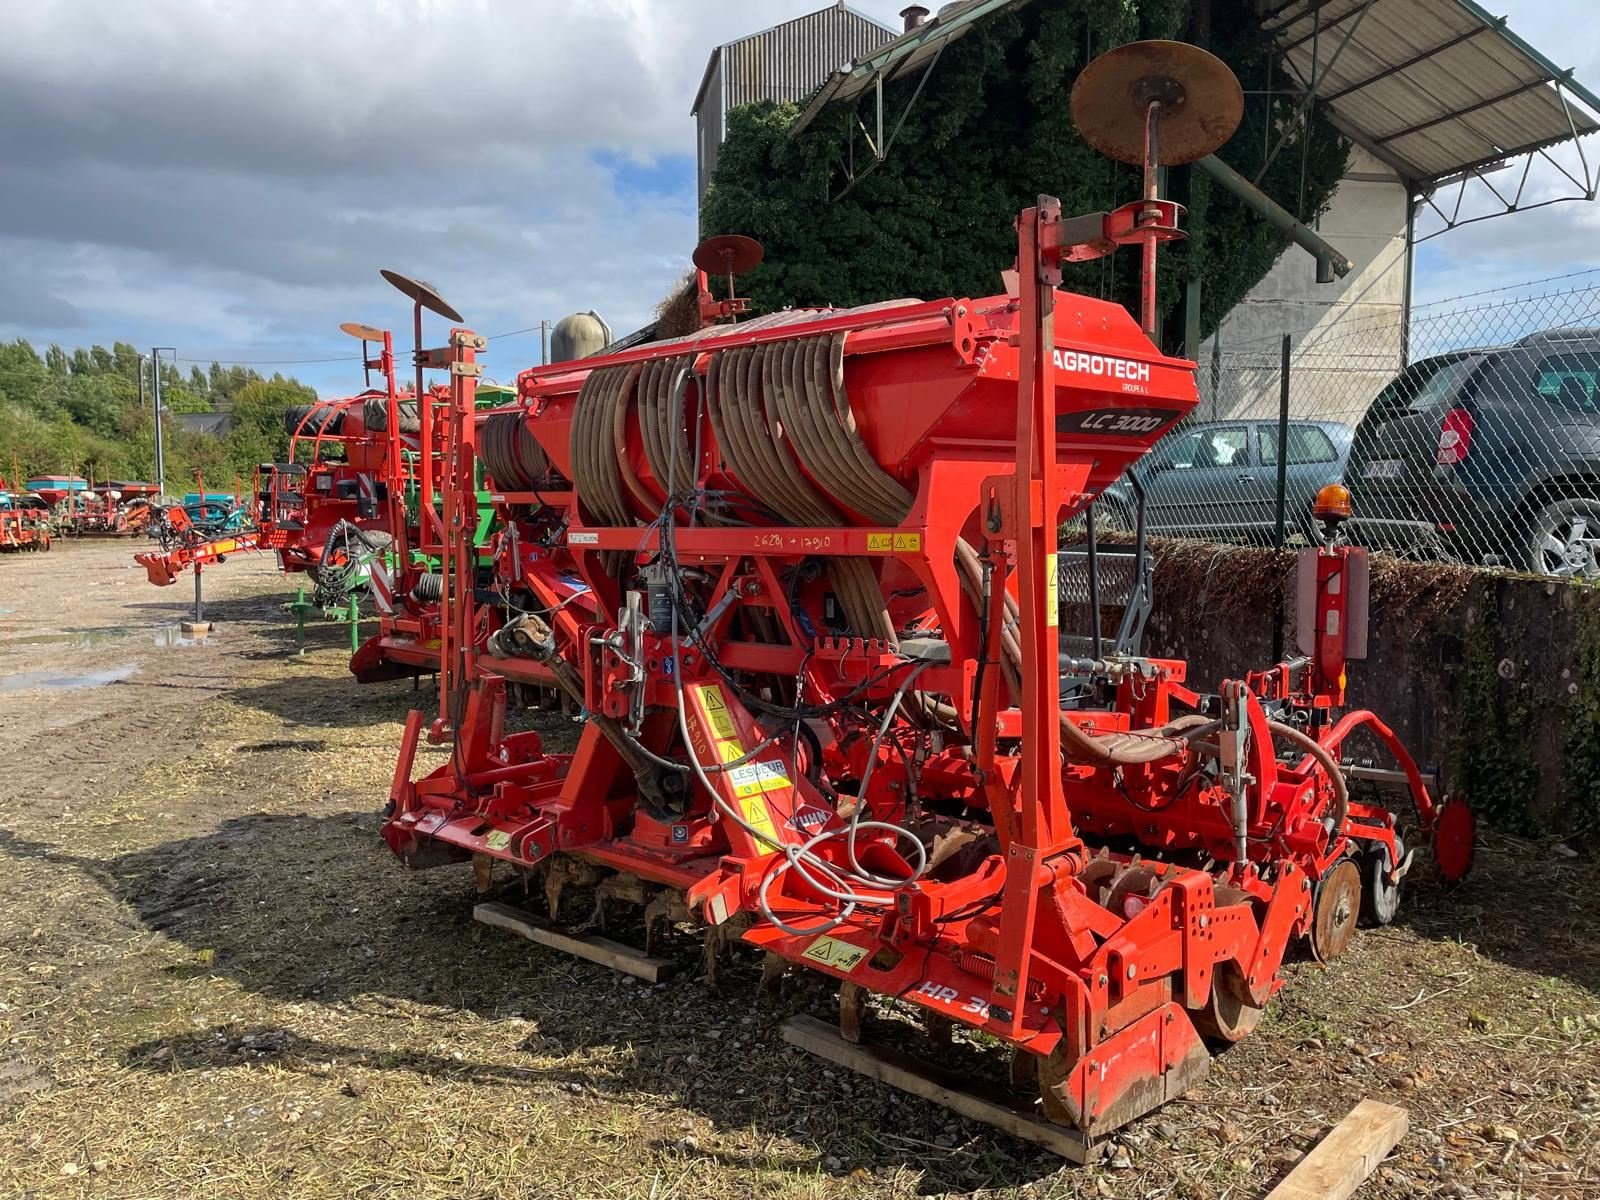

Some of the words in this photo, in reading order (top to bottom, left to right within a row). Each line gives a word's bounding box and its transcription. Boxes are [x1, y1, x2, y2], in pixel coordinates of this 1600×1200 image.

[1053, 349, 1150, 381] AGROTECH
[1080, 413, 1114, 429] LC
[1108, 415, 1162, 432] 3000
[800, 536, 831, 550] 17910
[731, 761, 784, 780] LESUEUR
[918, 981, 959, 1005] HR
